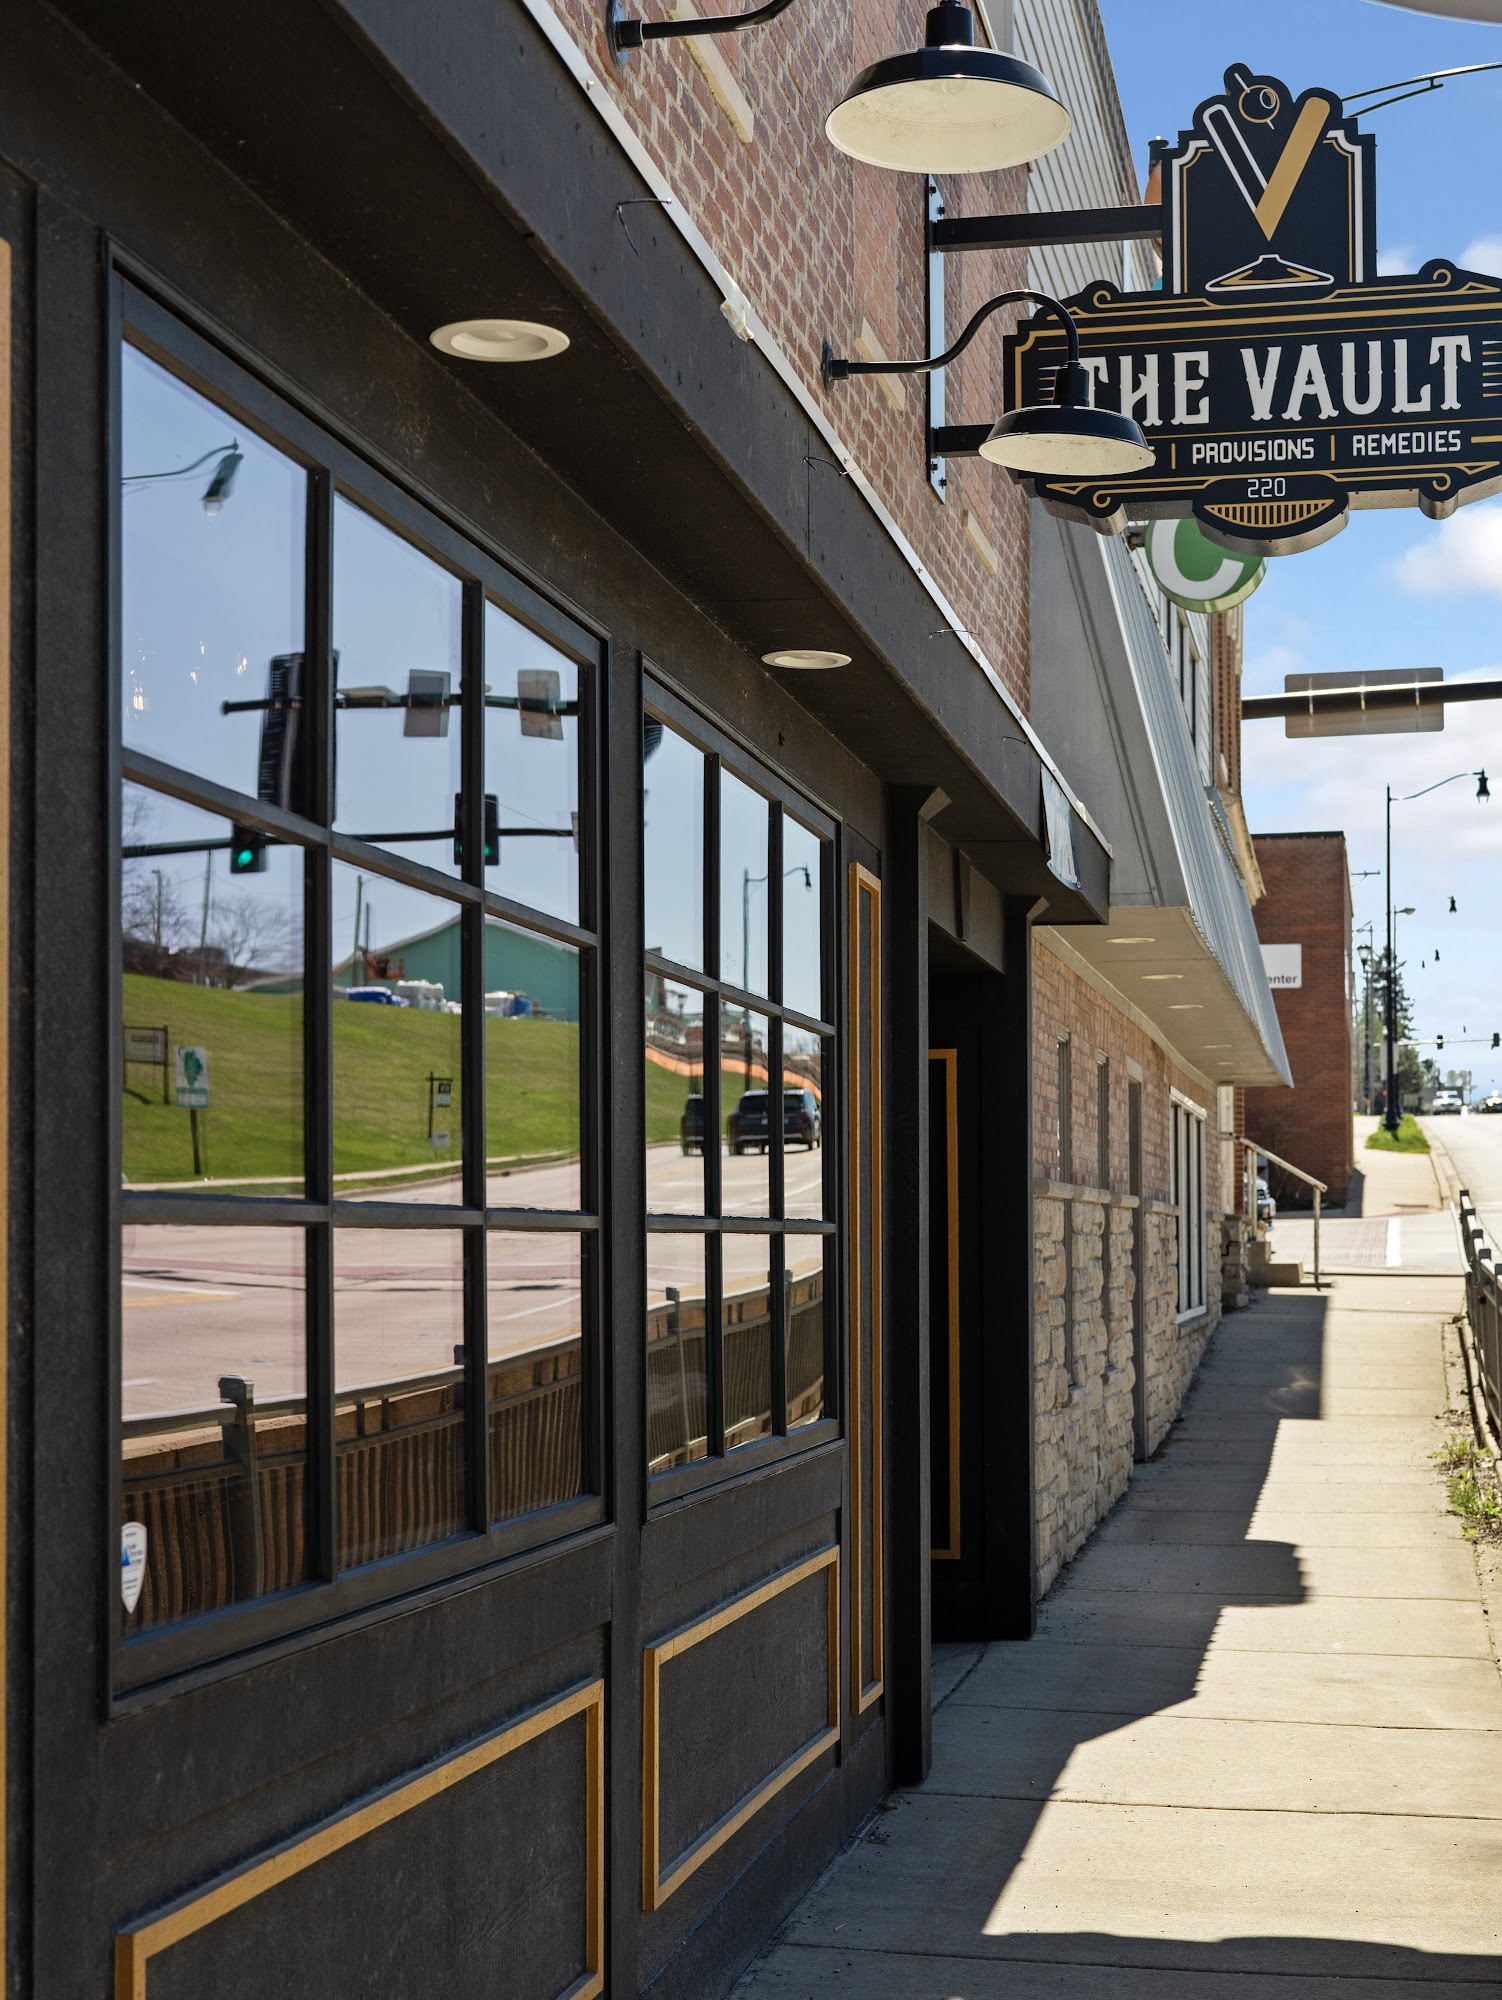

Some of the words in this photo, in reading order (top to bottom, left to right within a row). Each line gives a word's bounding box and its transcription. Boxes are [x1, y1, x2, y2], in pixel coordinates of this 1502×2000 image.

[1240, 335, 1472, 422] VAULT
[1192, 438, 1315, 465] PROVISIONS
[1353, 430, 1462, 456] REMEDIES
[1247, 478, 1286, 499] 220
[1267, 974, 1298, 985] enter
